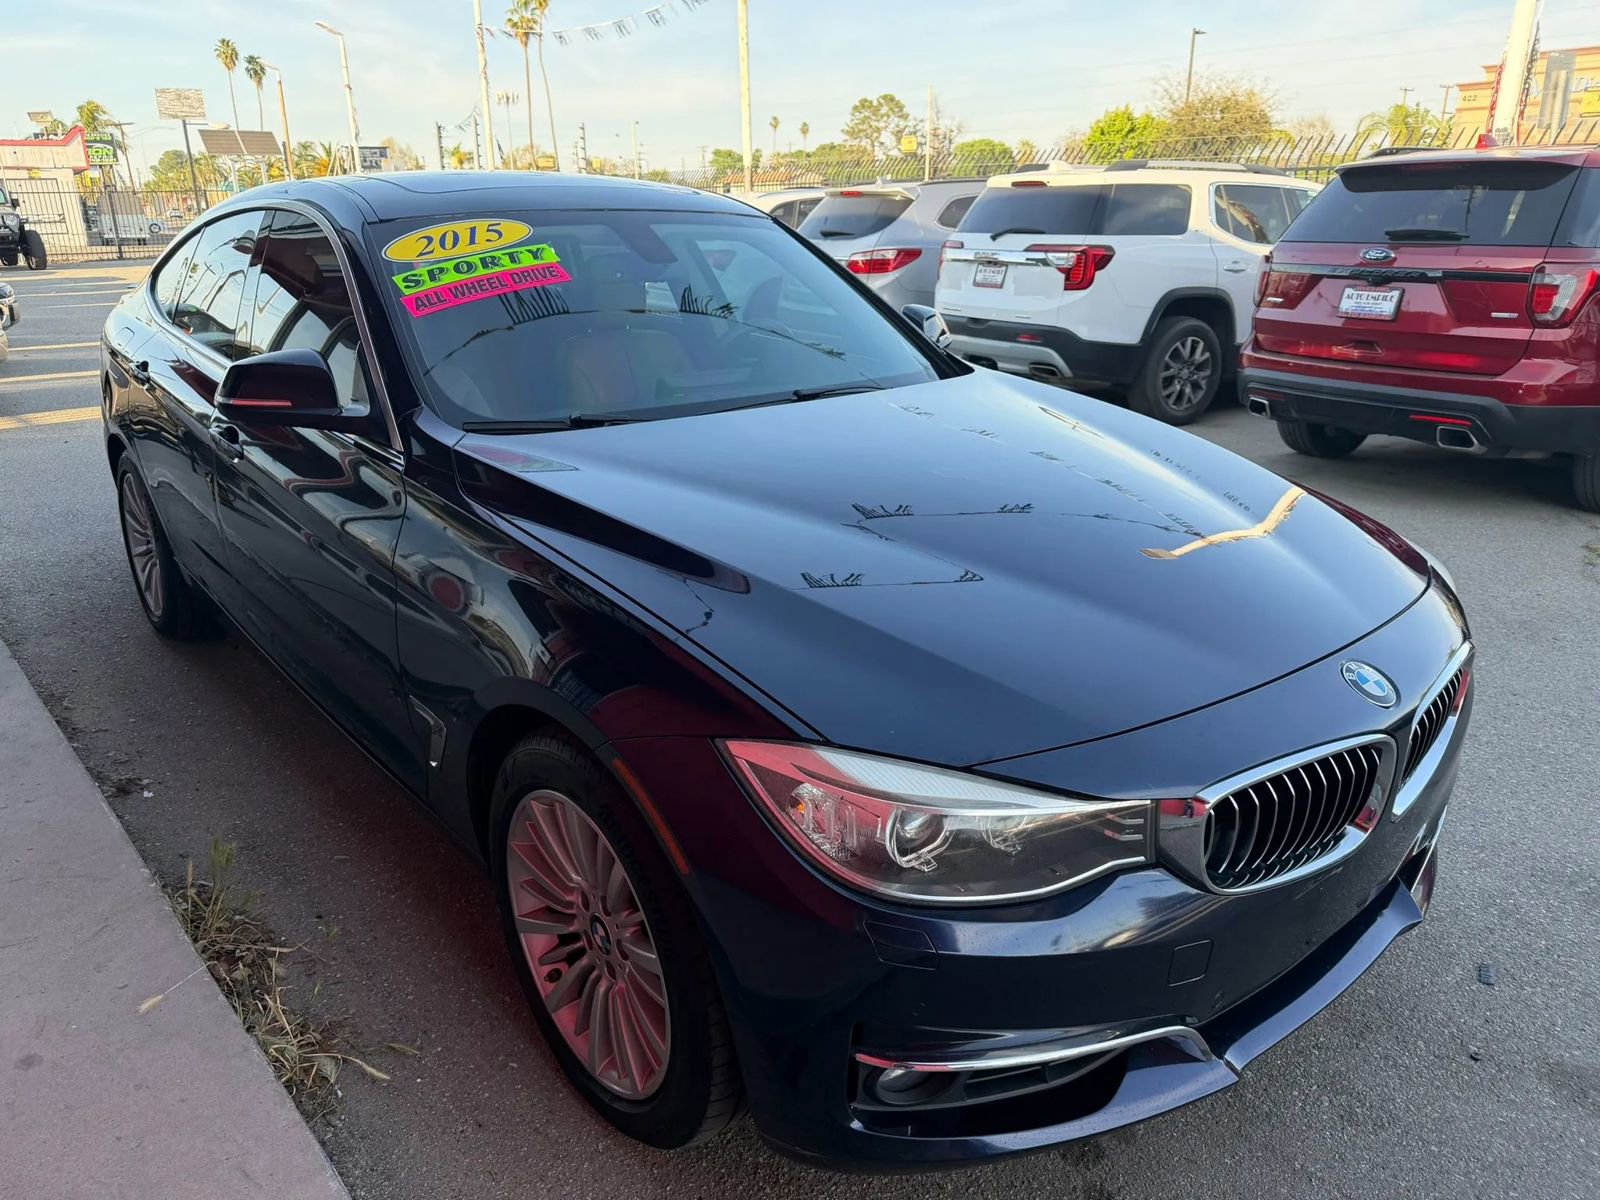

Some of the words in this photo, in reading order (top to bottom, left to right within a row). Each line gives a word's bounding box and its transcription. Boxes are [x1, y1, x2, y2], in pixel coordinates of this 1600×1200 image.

[415, 222, 504, 258] 2015
[1364, 249, 1387, 260] Ford
[401, 247, 546, 289] SPORTY
[414, 292, 448, 312] ALL
[449, 276, 509, 300] WHEEL
[512, 266, 560, 285] DRIVE
[1344, 292, 1365, 301] AUTO
